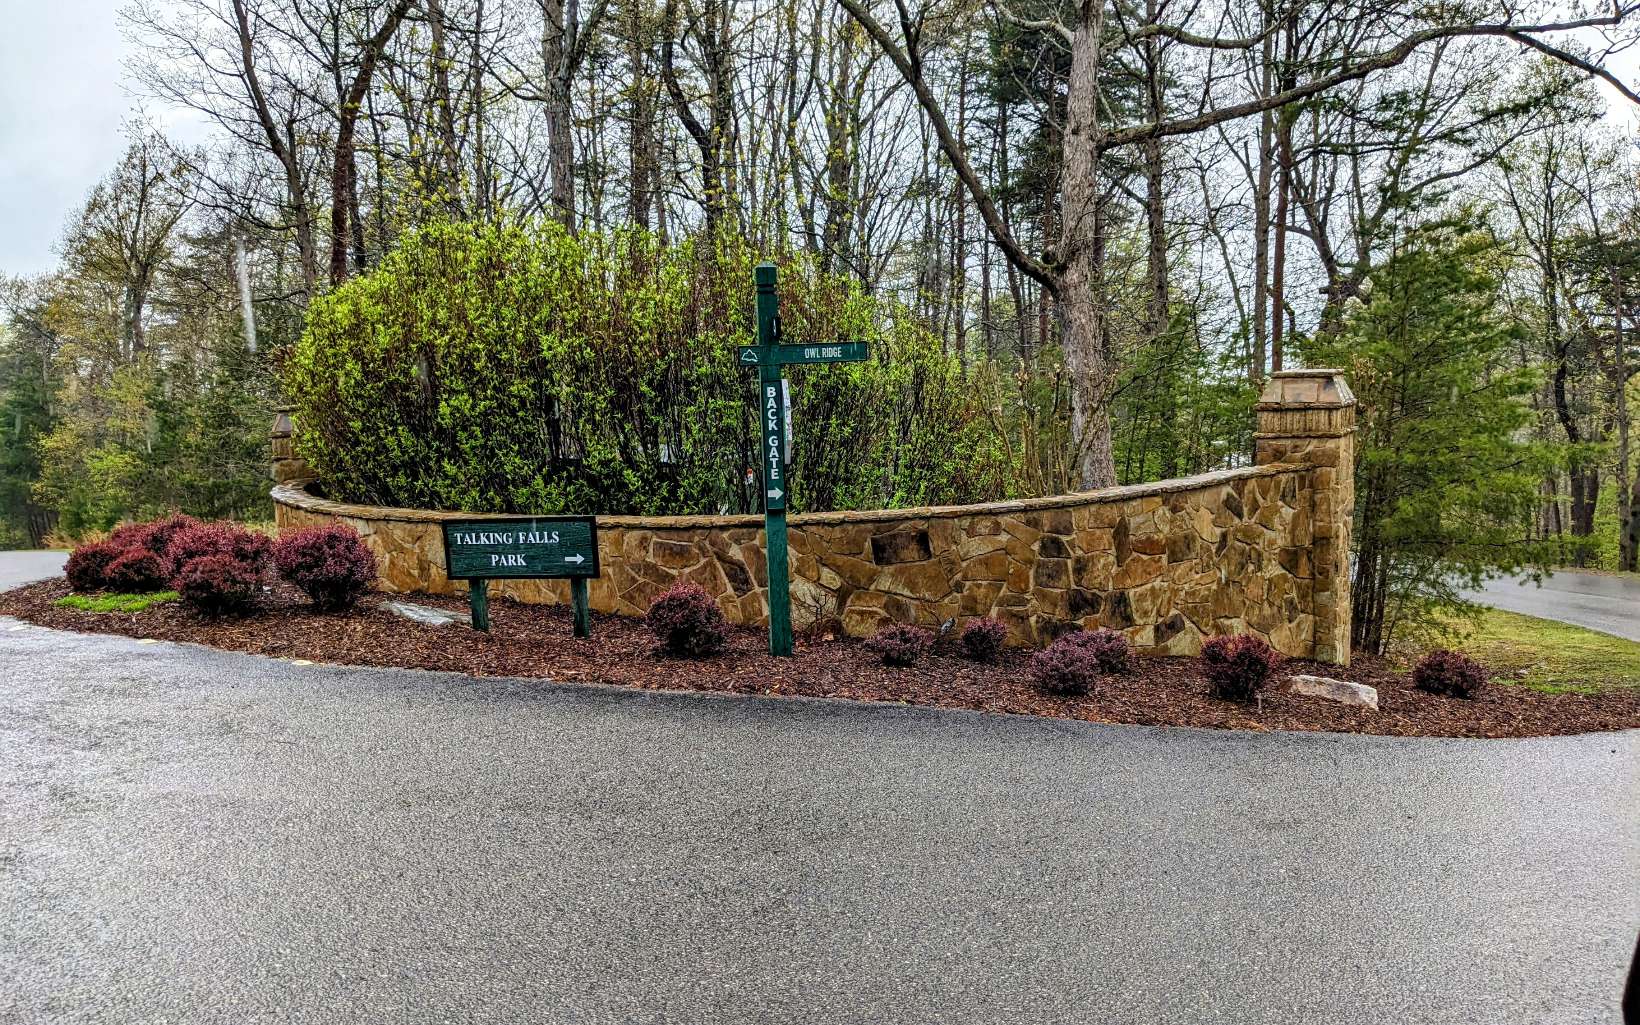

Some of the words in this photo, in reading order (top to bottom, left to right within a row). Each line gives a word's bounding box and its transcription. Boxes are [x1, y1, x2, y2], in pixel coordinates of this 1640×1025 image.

[804, 347, 821, 359] OWL
[822, 346, 842, 358] RIDGE
[766, 386, 778, 431] BACK
[768, 435, 780, 480] GATE
[454, 532, 513, 545] TALKING
[519, 531, 560, 544] FALLS
[491, 553, 528, 566] PARK
